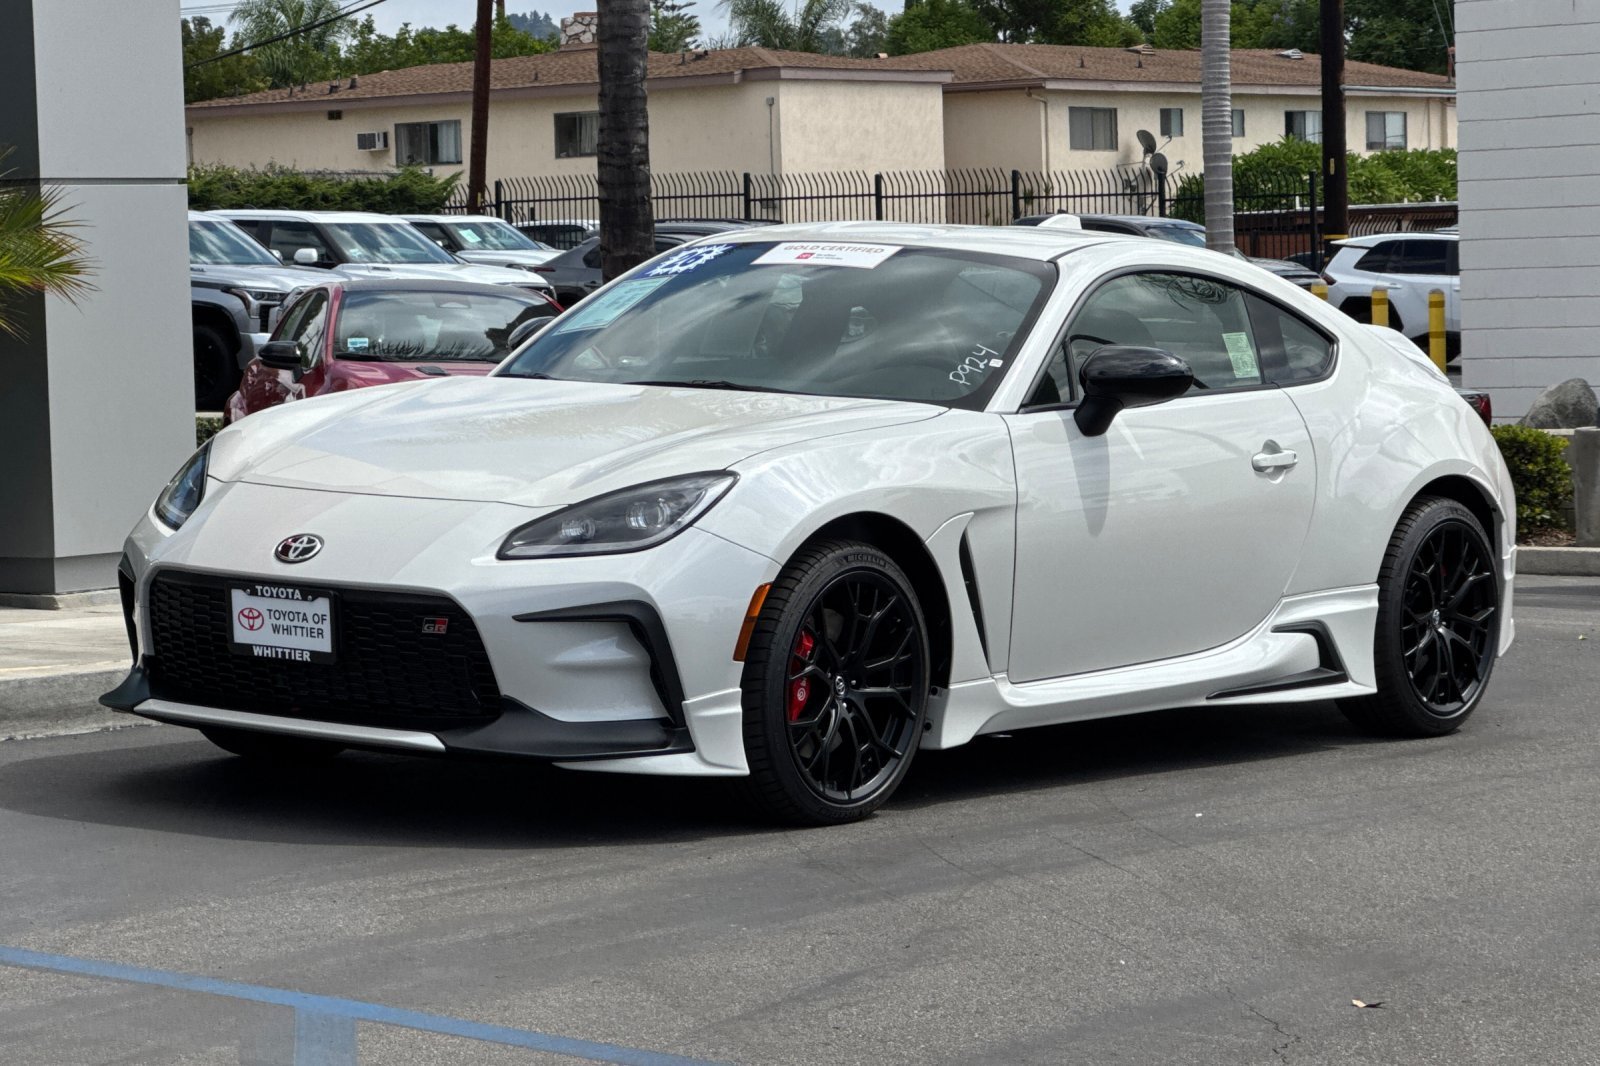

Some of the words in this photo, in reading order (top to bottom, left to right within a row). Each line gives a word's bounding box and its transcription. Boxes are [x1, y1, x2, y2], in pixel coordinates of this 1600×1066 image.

[820, 245, 885, 253] CERTIFIED
[255, 585, 302, 600] TOYOTA
[266, 608, 309, 624] TOYOTA
[312, 613, 328, 625] OF
[271, 623, 325, 639] WHITTIER
[423, 622, 448, 633] GR
[252, 645, 311, 662] WHITTIER
